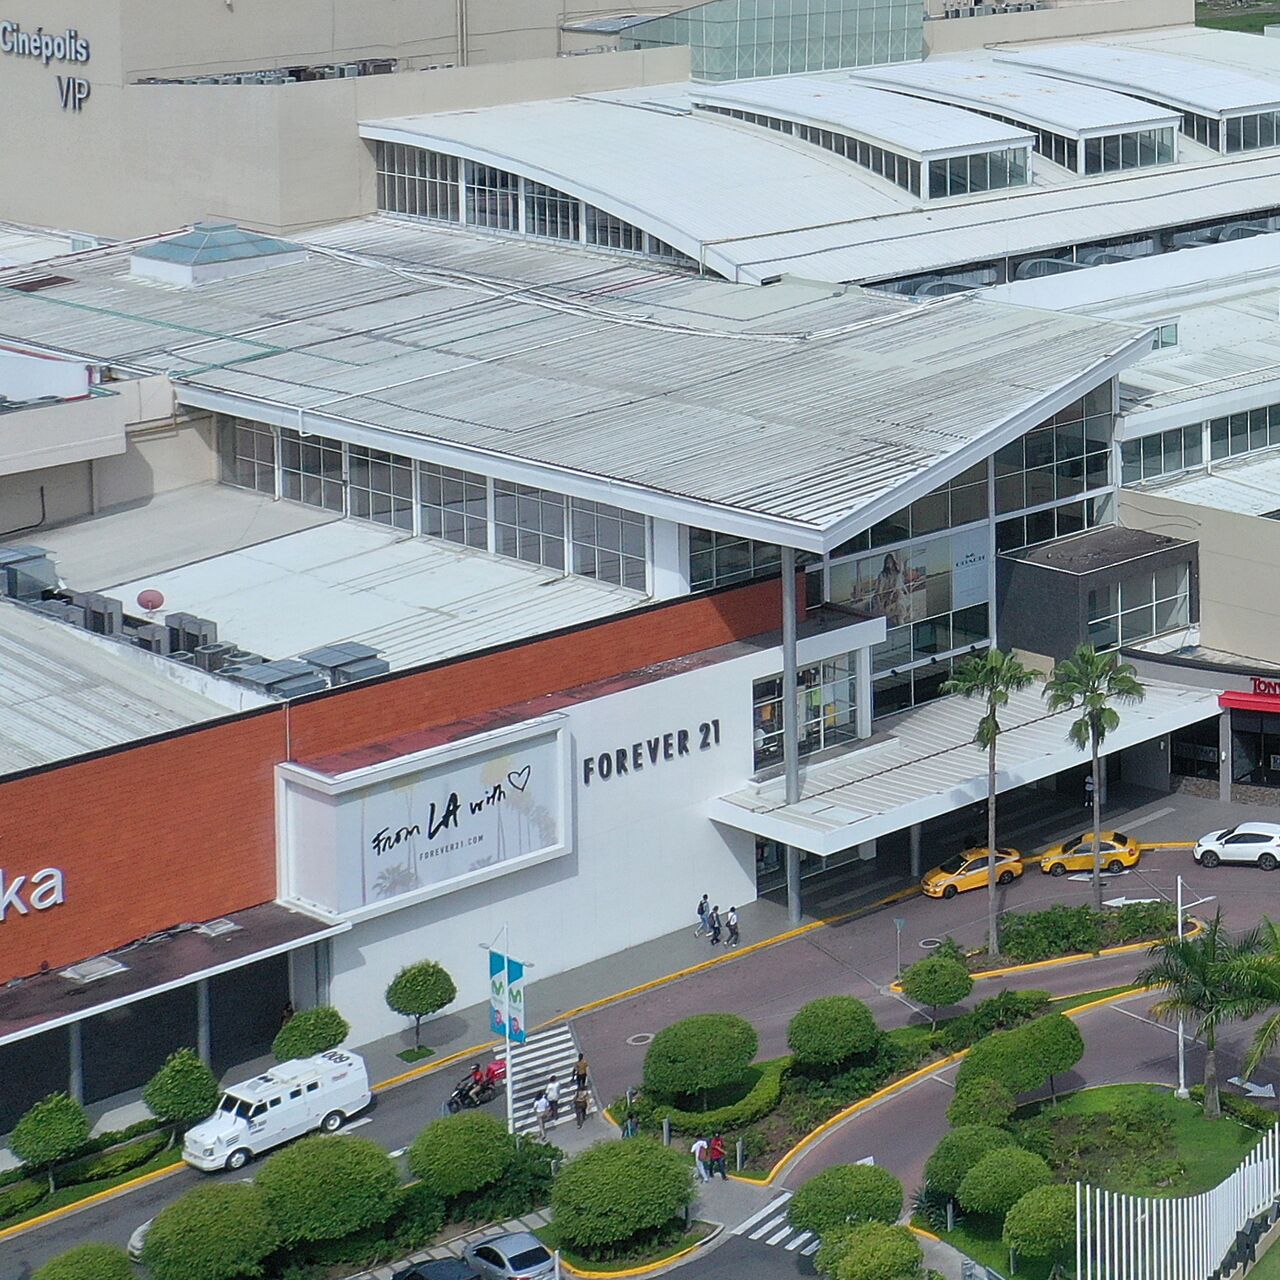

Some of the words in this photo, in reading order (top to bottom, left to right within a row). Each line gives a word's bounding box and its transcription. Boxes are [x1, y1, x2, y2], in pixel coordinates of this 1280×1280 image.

[0, 20, 91, 67] Cinépolis
[57, 75, 91, 111] VIP
[583, 729, 690, 786] FOREVER
[699, 718, 721, 751] 21
[371, 826, 421, 856] From
[427, 792, 461, 840] LA
[470, 783, 506, 815] with
[419, 834, 485, 861] FOREVER21.COM
